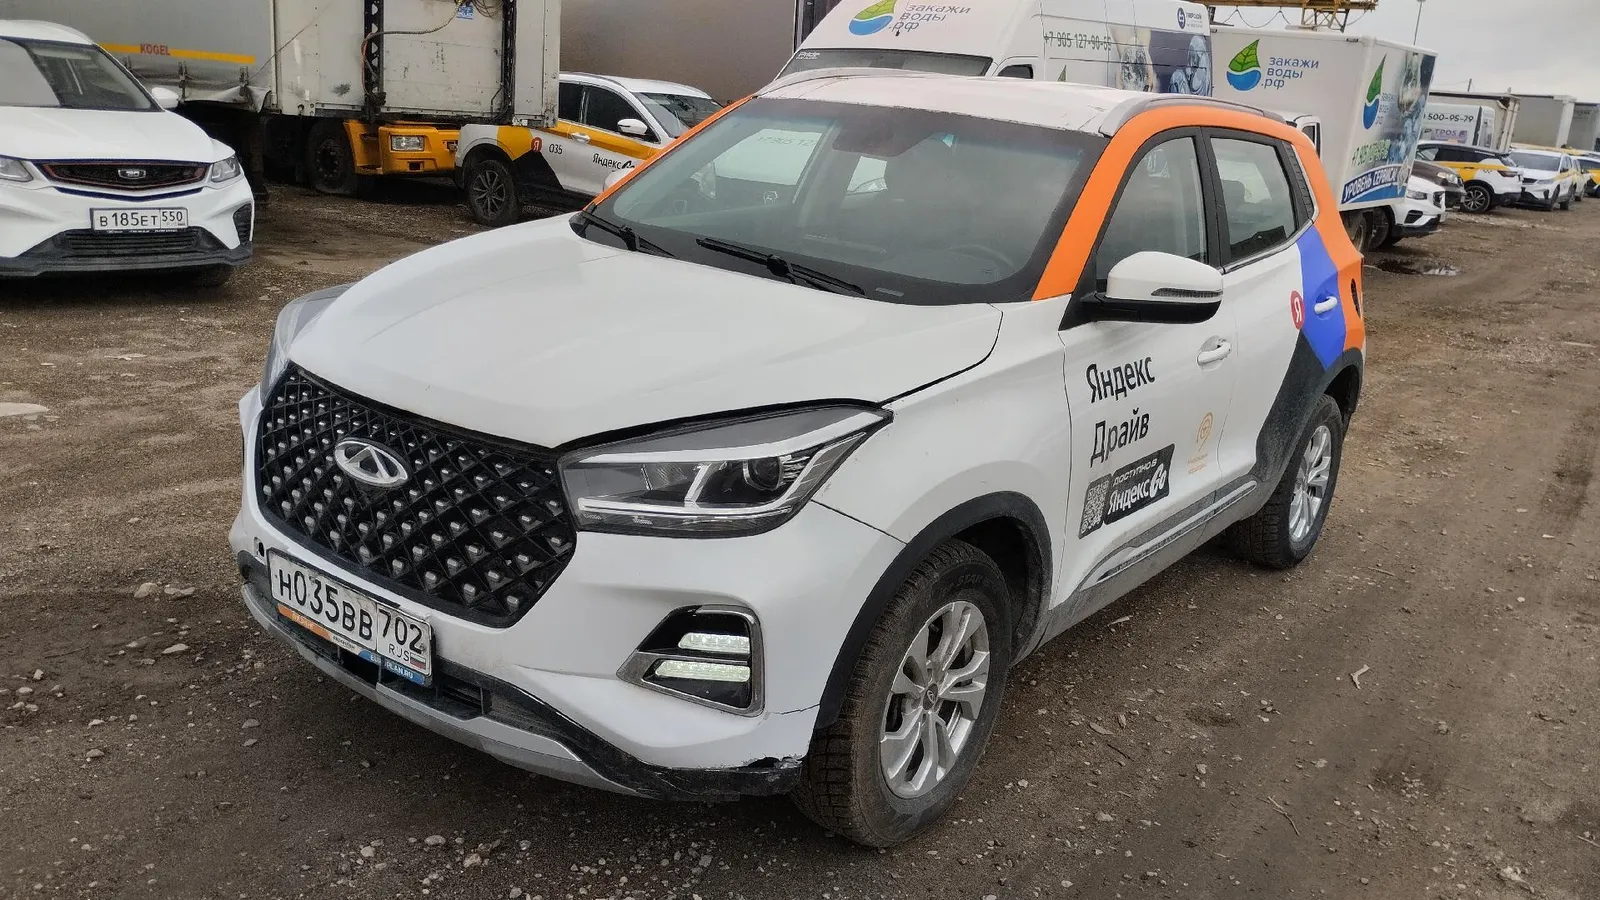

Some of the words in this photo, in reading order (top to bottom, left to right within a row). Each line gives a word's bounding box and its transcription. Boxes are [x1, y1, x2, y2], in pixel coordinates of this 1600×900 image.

[900, 12, 946, 22] воды
[906, 5, 971, 14] закажи
[1056, 31, 1072, 48] 905
[1269, 56, 1319, 69] закажи
[1267, 67, 1303, 79] воды
[1261, 78, 1285, 90] .рф
[548, 143, 563, 155] 035
[592, 153, 622, 170] Яндекс
[1343, 172, 1373, 202] УРОВЕНЬ
[161, 211, 183, 222] 550
[1086, 356, 1155, 404] Яндекс
[1090, 407, 1150, 468] Драйв
[1112, 461, 1152, 487] ДОСТУПНО
[1107, 478, 1151, 515] Яндекс
[1149, 463, 1167, 498] Go
[379, 608, 424, 654] 702
